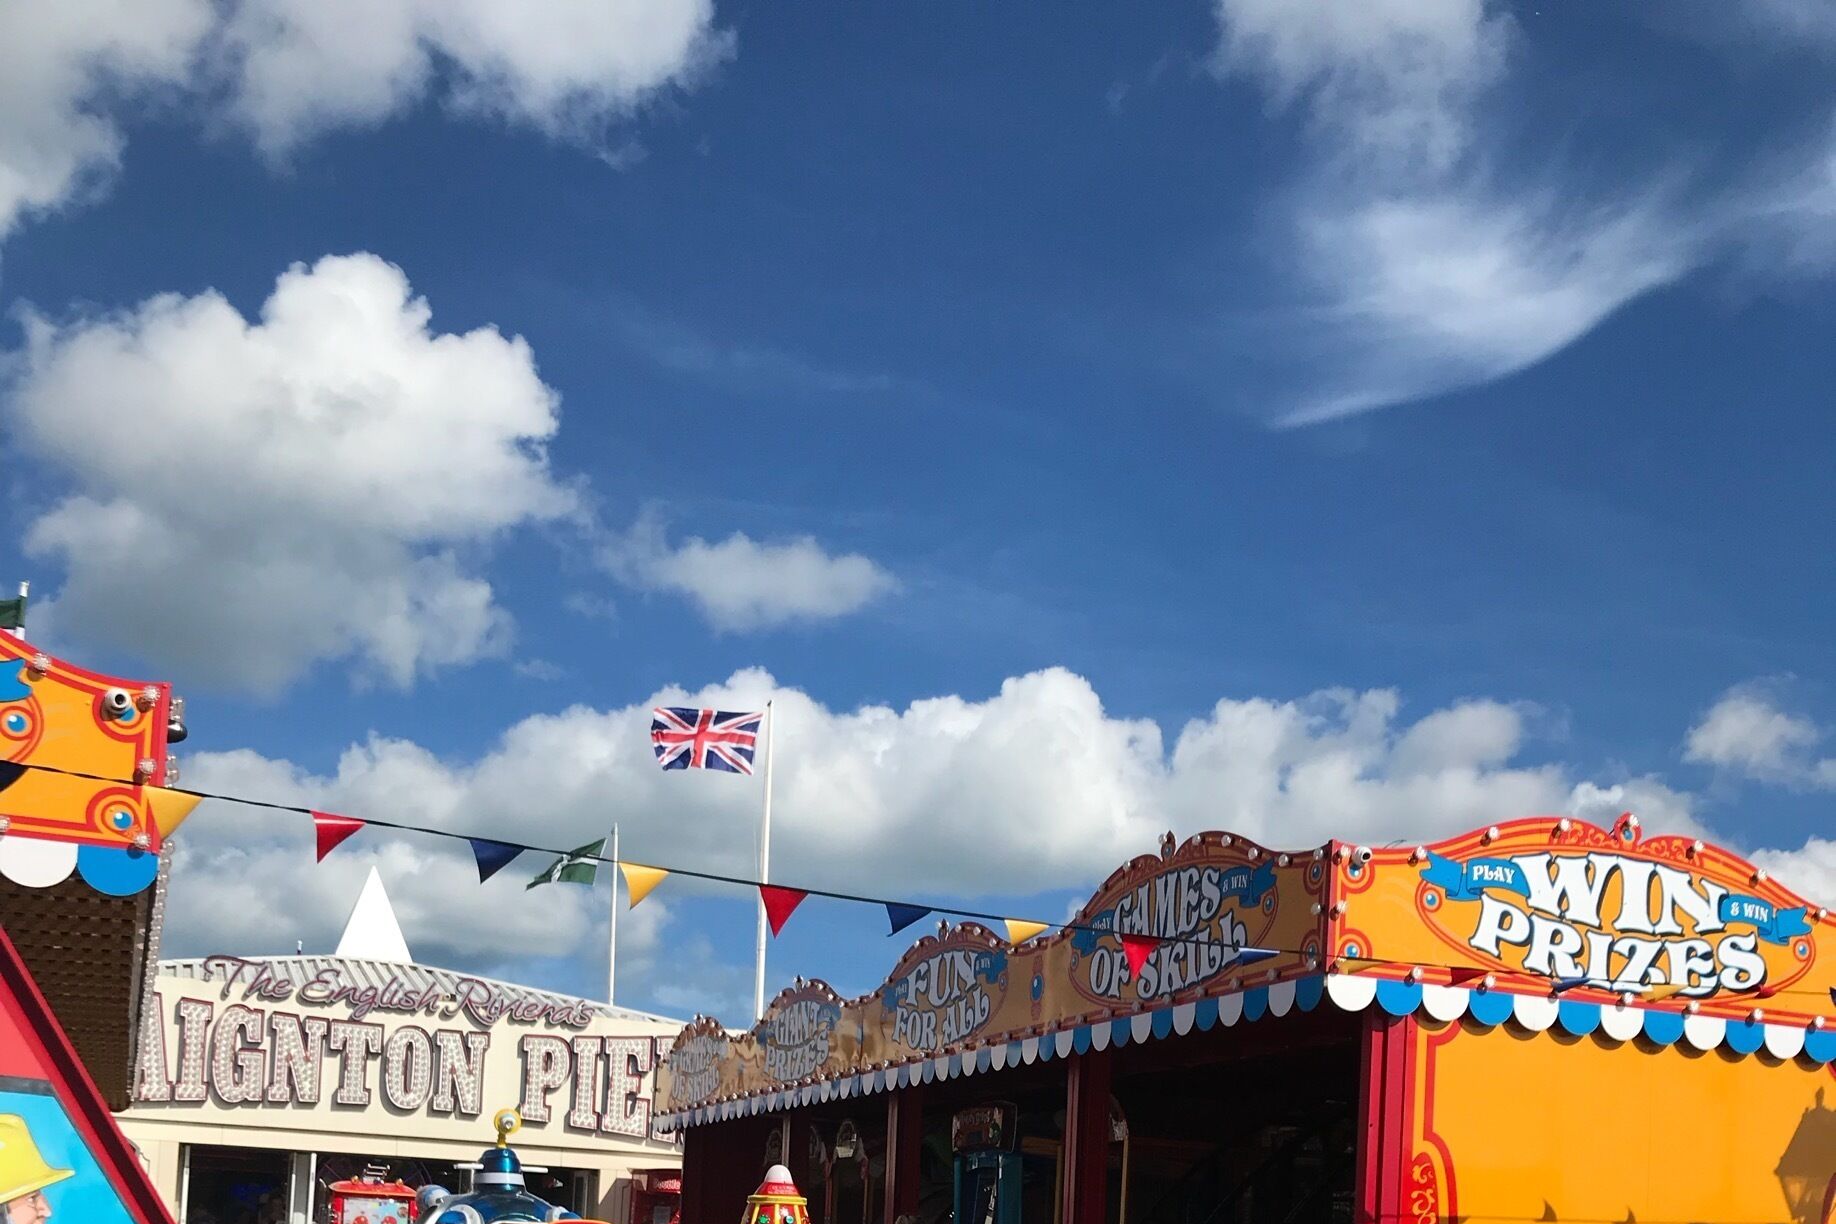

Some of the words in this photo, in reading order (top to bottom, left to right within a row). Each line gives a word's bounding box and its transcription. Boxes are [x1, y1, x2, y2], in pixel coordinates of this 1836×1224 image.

[1231, 874, 1248, 889] WIN
[1472, 863, 1515, 884] PLAY
[1510, 853, 1728, 935] WIN
[1113, 867, 1221, 944] GAMES
[1730, 901, 1740, 917] &
[1743, 903, 1768, 923] WIN
[1090, 946, 1130, 999] OF
[1137, 909, 1247, 999] SKILL
[1469, 893, 1765, 997] PRIZES
[203, 955, 293, 1000] The
[297, 968, 440, 1021] English
[440, 978, 595, 1027] Riviera's
[905, 950, 979, 1008] FUN
[775, 1001, 821, 1047] GIANT
[892, 1005, 937, 1050] FOR
[943, 985, 990, 1046] ALL
[764, 1030, 829, 1082] PRIZES
